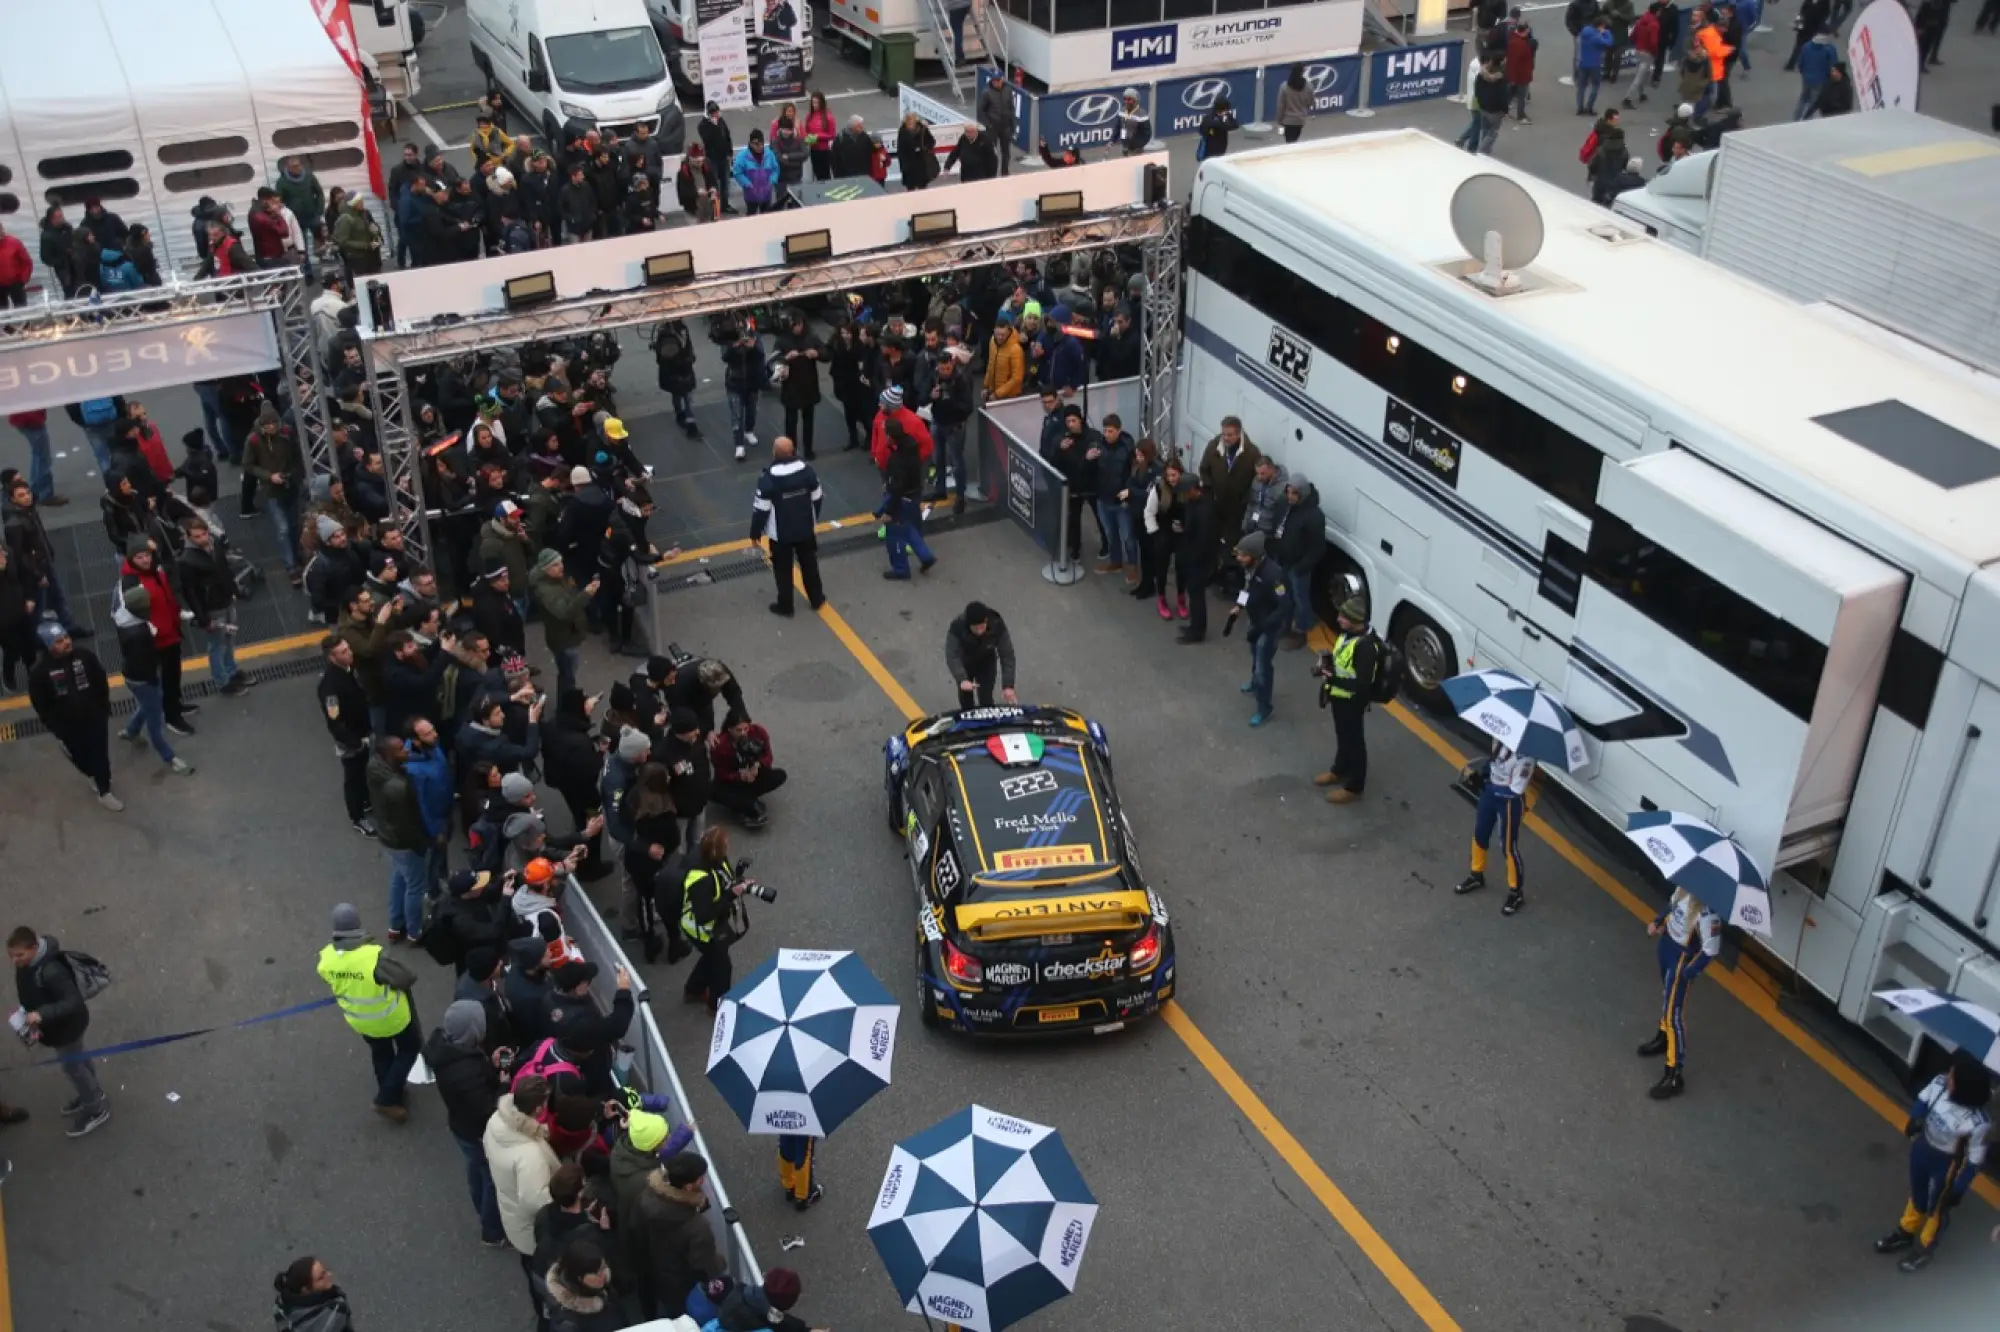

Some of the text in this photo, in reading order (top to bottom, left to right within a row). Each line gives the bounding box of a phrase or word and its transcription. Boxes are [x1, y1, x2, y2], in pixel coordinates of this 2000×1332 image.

[1215, 17, 1281, 35] HYUNDAI
[1117, 35, 1172, 60] HMI
[1387, 47, 1448, 78] HMI
[1059, 128, 1112, 146] HYUND
[1269, 333, 1310, 384] 222
[1000, 770, 1058, 801] 222
[994, 812, 1077, 829] Fred Mello
[1002, 848, 1085, 868] PIRELLI
[1044, 956, 1127, 977] checkstar
[928, 1295, 972, 1312] MAGNETI
